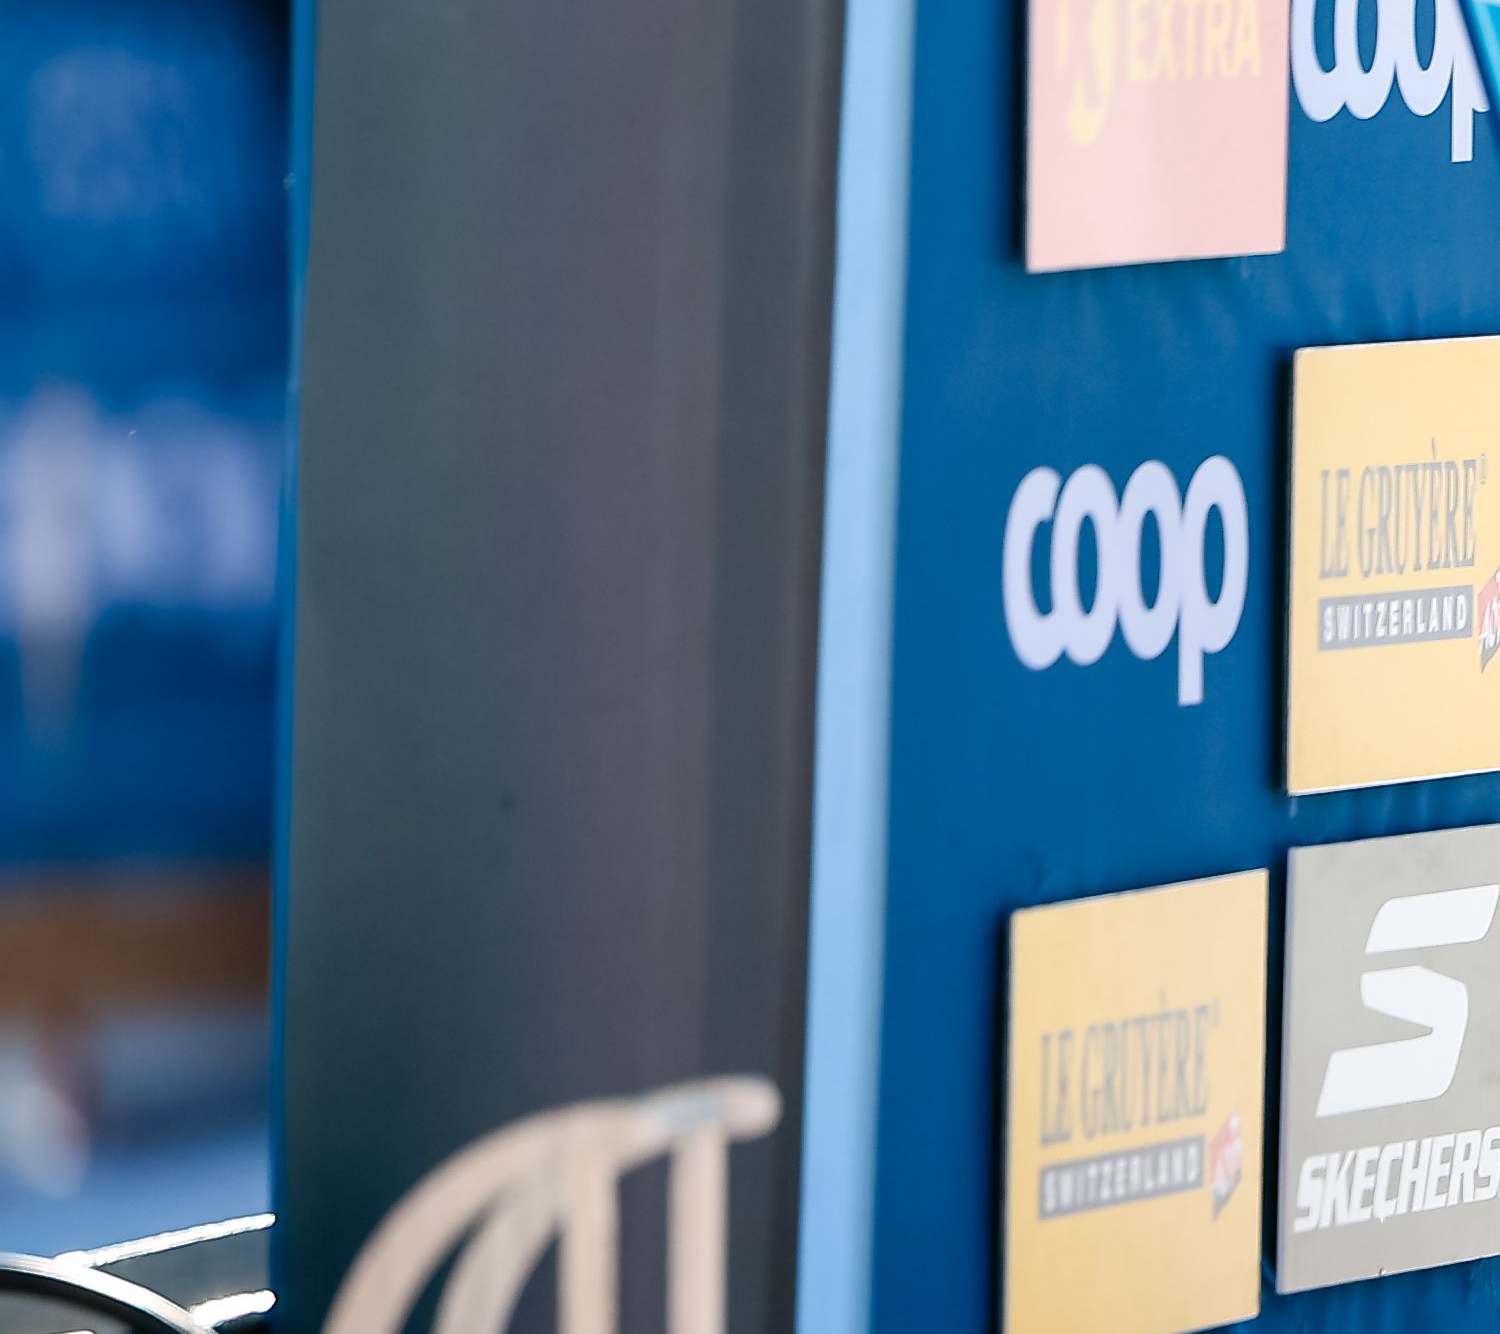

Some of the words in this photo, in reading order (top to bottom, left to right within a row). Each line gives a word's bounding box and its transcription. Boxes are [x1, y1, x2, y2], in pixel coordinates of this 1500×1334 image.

[1317, 468, 1351, 580] LE
[1357, 437, 1476, 573] GRUYÈRE
[1003, 455, 1249, 706] coop
[1322, 596, 1470, 645] SWITZERLAND
